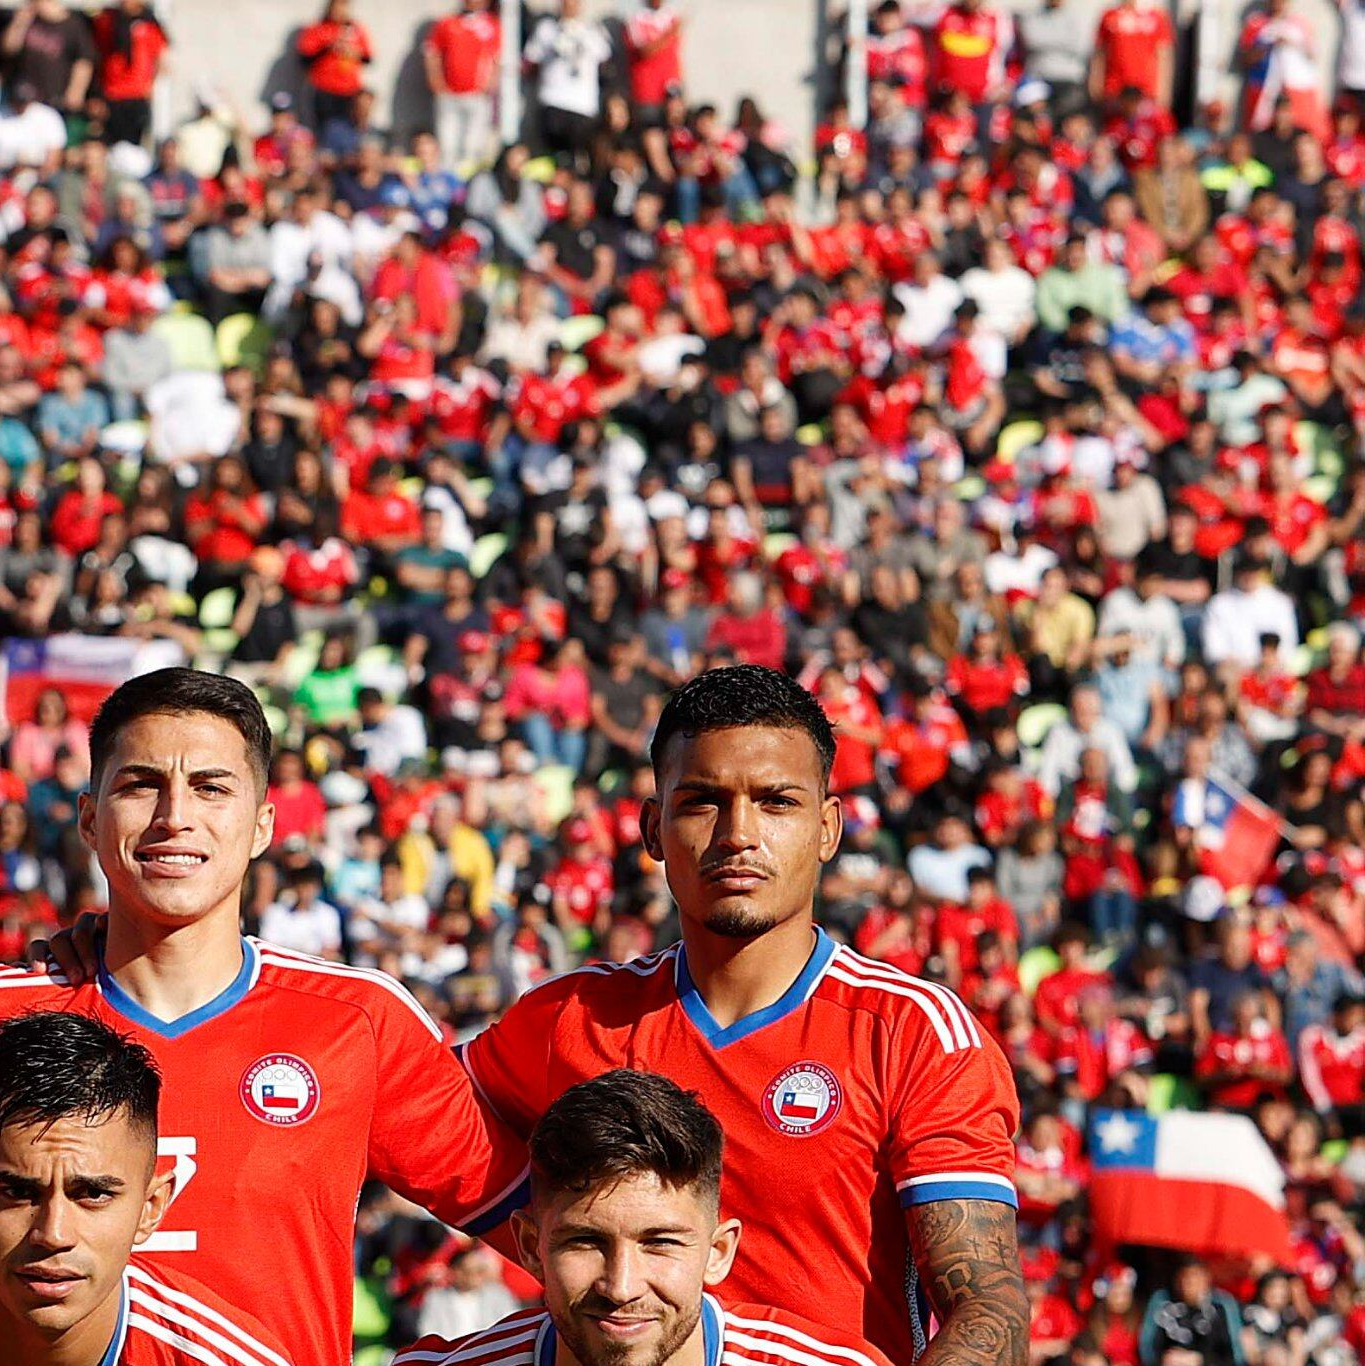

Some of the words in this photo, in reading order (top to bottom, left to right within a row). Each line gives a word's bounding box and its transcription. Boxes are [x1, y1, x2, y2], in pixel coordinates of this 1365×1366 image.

[247, 1058, 273, 1086] COMITE
[276, 1057, 314, 1088] OLIMPICO
[770, 1066, 801, 1092] COMITE
[804, 1065, 836, 1097] OLIMPICO
[265, 1114, 298, 1123] CHILE
[779, 1122, 811, 1133] CHILE
